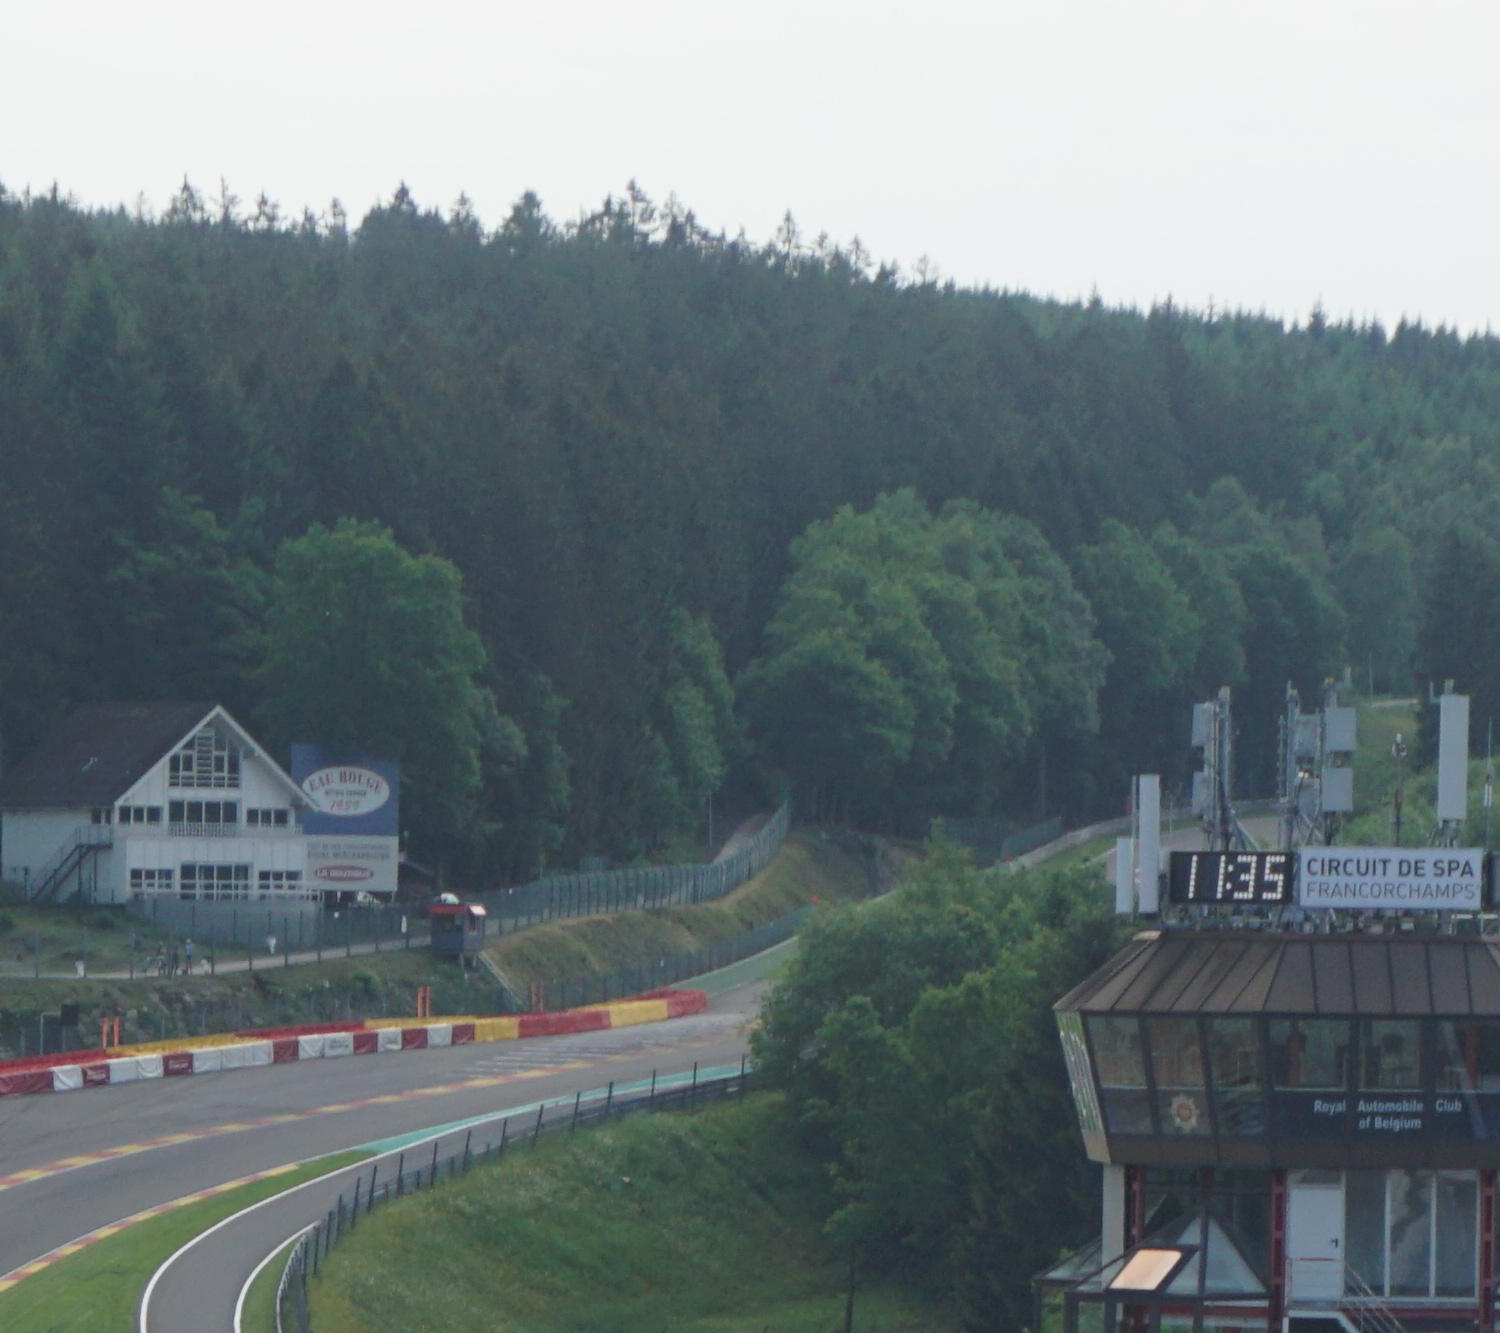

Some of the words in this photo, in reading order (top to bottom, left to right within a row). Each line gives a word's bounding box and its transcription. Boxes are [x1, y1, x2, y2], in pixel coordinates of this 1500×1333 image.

[1186, 854, 1286, 901] 11:35
[1306, 858, 1395, 878] CIRCUIT
[1398, 858, 1426, 878] DE
[1432, 858, 1474, 879] SPA
[1306, 880, 1474, 901] FRANCORCHAMPS
[1313, 1100, 1346, 1116] Royal
[1358, 1100, 1424, 1113] Automobile
[1435, 1098, 1462, 1113] Club
[1359, 1117, 1371, 1129] of
[1374, 1117, 1422, 1132] Belgium
